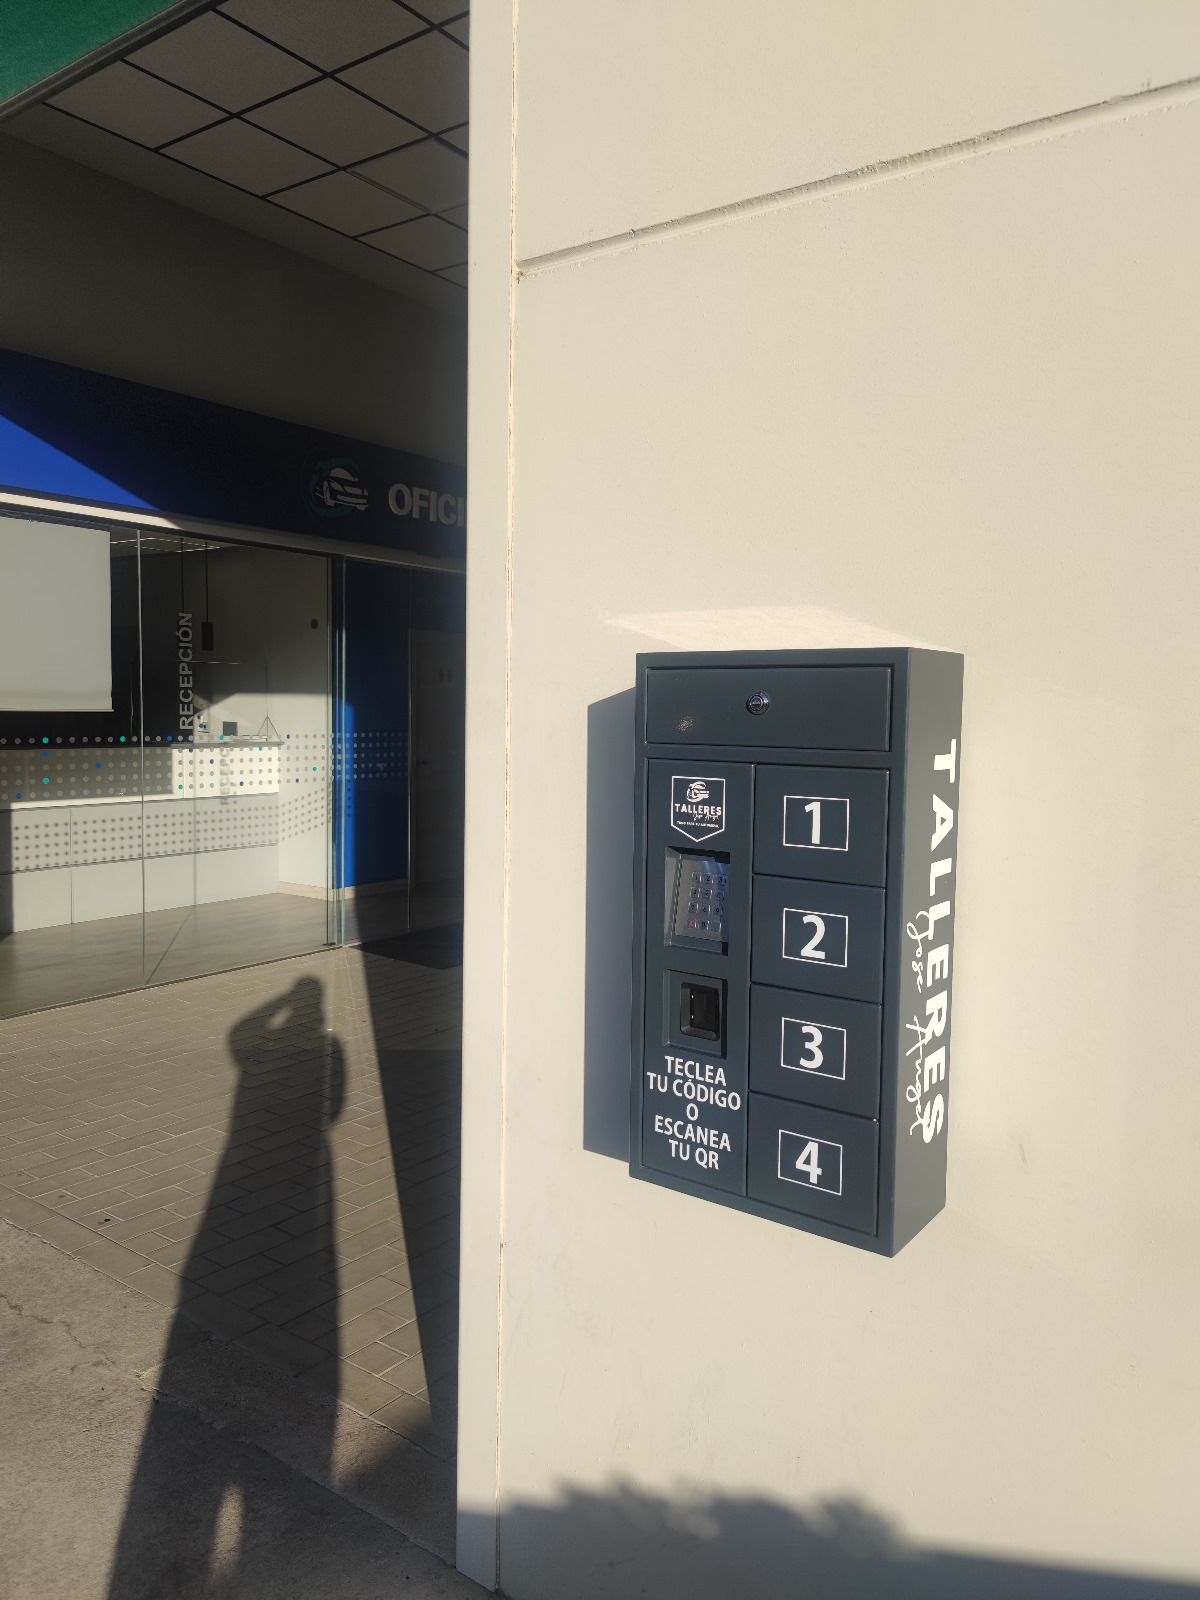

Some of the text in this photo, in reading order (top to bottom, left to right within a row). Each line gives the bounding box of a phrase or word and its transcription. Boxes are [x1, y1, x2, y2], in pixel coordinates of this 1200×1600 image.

[388, 483, 465, 527] OFICI
[176, 612, 194, 730] RECEPCIÓN
[674, 803, 722, 816] TALLERES
[804, 801, 821, 845] 1
[800, 914, 826, 960] 2
[923, 738, 957, 1144] TALLERES
[799, 1025, 824, 1069] 3
[646, 1071, 741, 1111] TU CÓDIGO
[664, 1055, 727, 1087] TECLEA
[654, 1114, 732, 1152] ESCANEA
[686, 1102, 699, 1121] O
[668, 1138, 720, 1171] TU QR
[795, 1140, 823, 1185] 4
